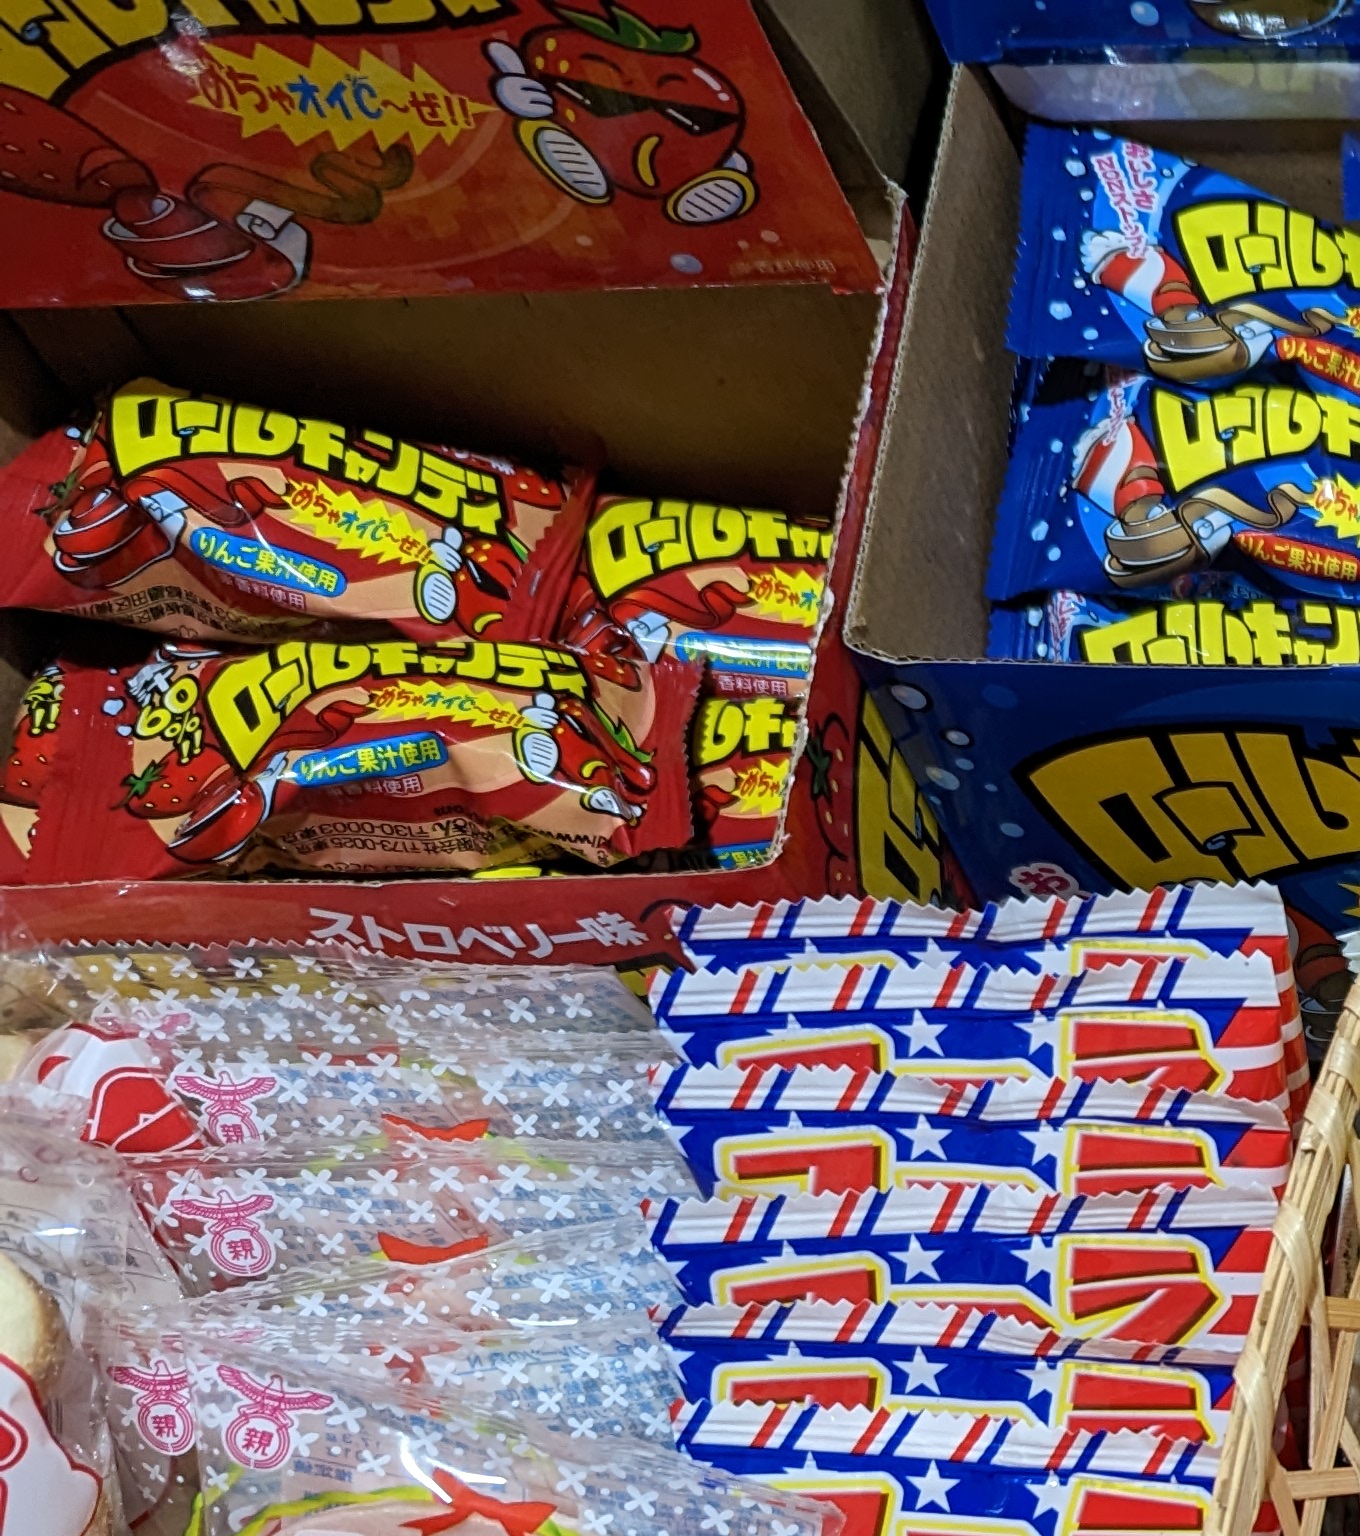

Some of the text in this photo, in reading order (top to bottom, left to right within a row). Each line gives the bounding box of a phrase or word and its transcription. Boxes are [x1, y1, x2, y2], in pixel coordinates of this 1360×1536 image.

[199, 531, 340, 595] りんご果汁使用
[299, 737, 442, 780] りんご果汁使用
[308, 906, 650, 961] ストロベリー味
